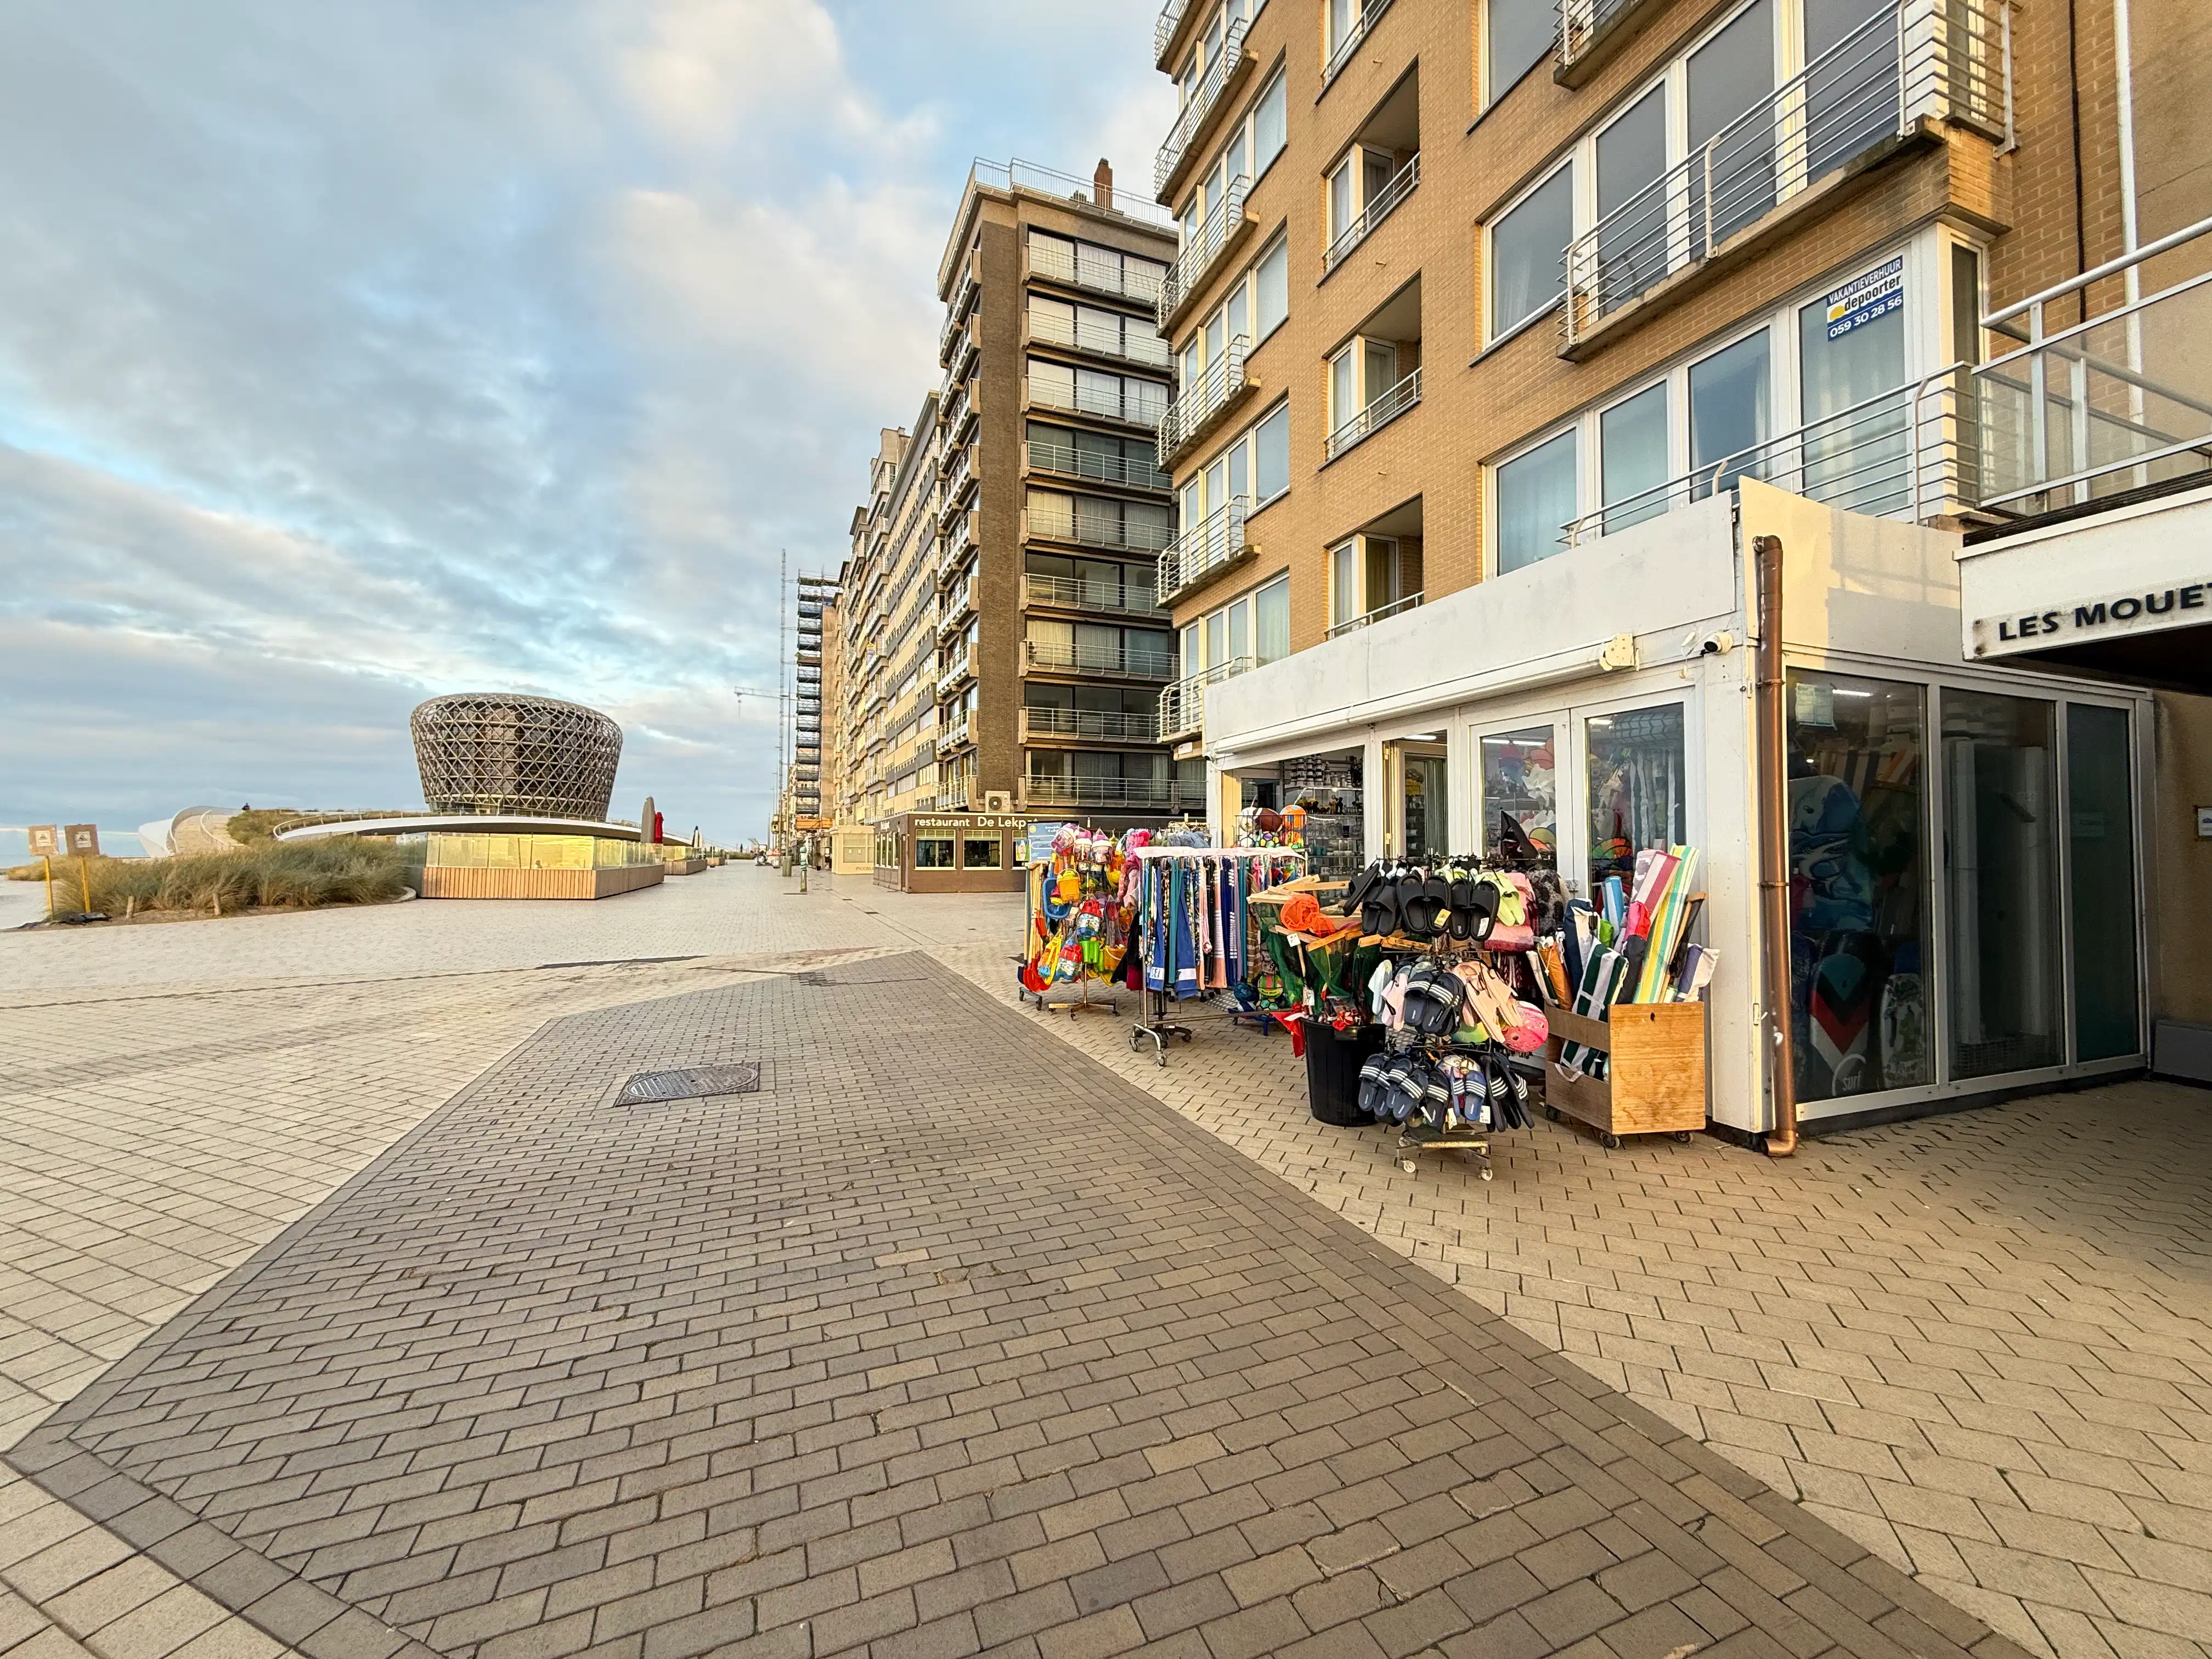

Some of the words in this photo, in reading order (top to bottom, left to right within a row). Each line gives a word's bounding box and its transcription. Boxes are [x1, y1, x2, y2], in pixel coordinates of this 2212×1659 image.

[1829, 259, 1901, 304] VAKANTIEVERHUUR
[1844, 275, 1901, 311] depoorter
[1830, 321, 1852, 337] 059
[1854, 312, 1869, 326] 30
[1871, 304, 1885, 318] 28
[1887, 295, 1902, 310] 56
[1999, 612, 2060, 641] LES
[2075, 583, 2212, 628] MOUE
[915, 817, 970, 827] restaurant
[978, 816, 994, 827] De
[998, 816, 1039, 830] Lekp
